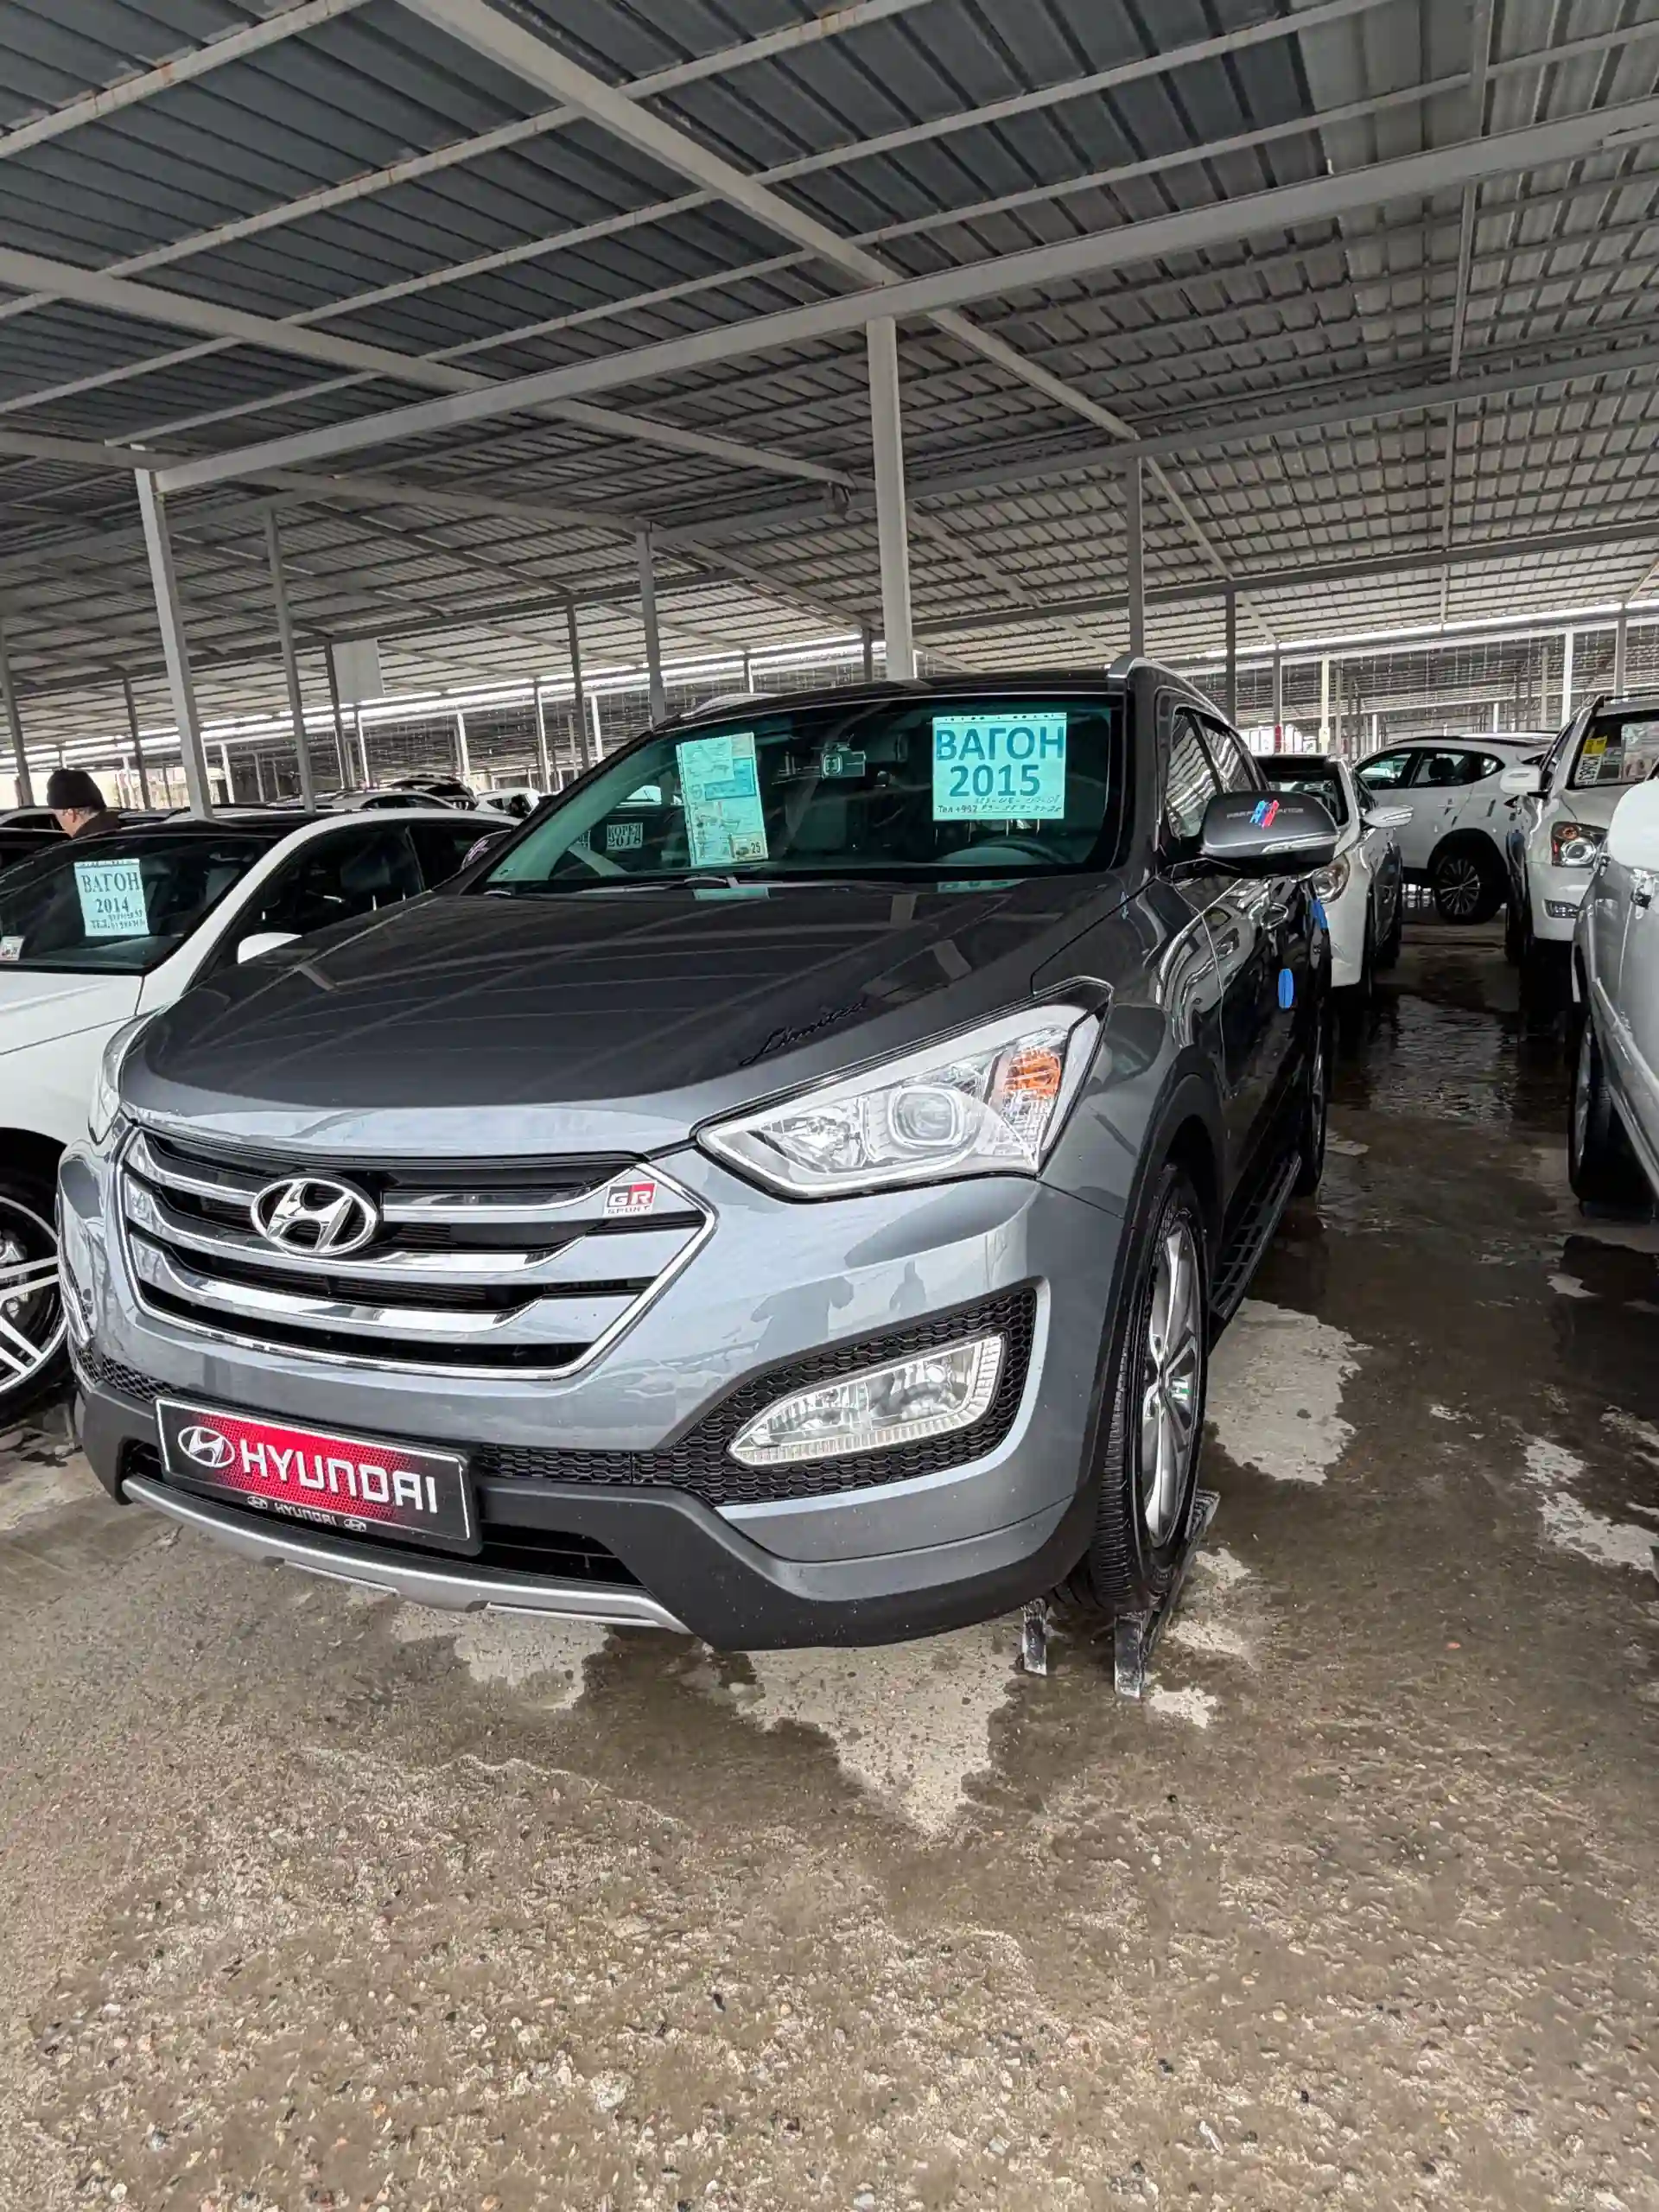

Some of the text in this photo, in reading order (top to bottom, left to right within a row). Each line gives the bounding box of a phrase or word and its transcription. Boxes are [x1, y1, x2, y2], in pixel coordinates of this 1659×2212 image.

[936, 726, 1064, 761] ВАГОН
[949, 764, 1040, 798] 2015
[81, 872, 140, 893] ВАГОН
[96, 897, 129, 913] 2014
[608, 1191, 652, 1206] GR
[239, 1438, 438, 1514] HYUNDAI
[273, 1503, 338, 1526] HYUNDAI
